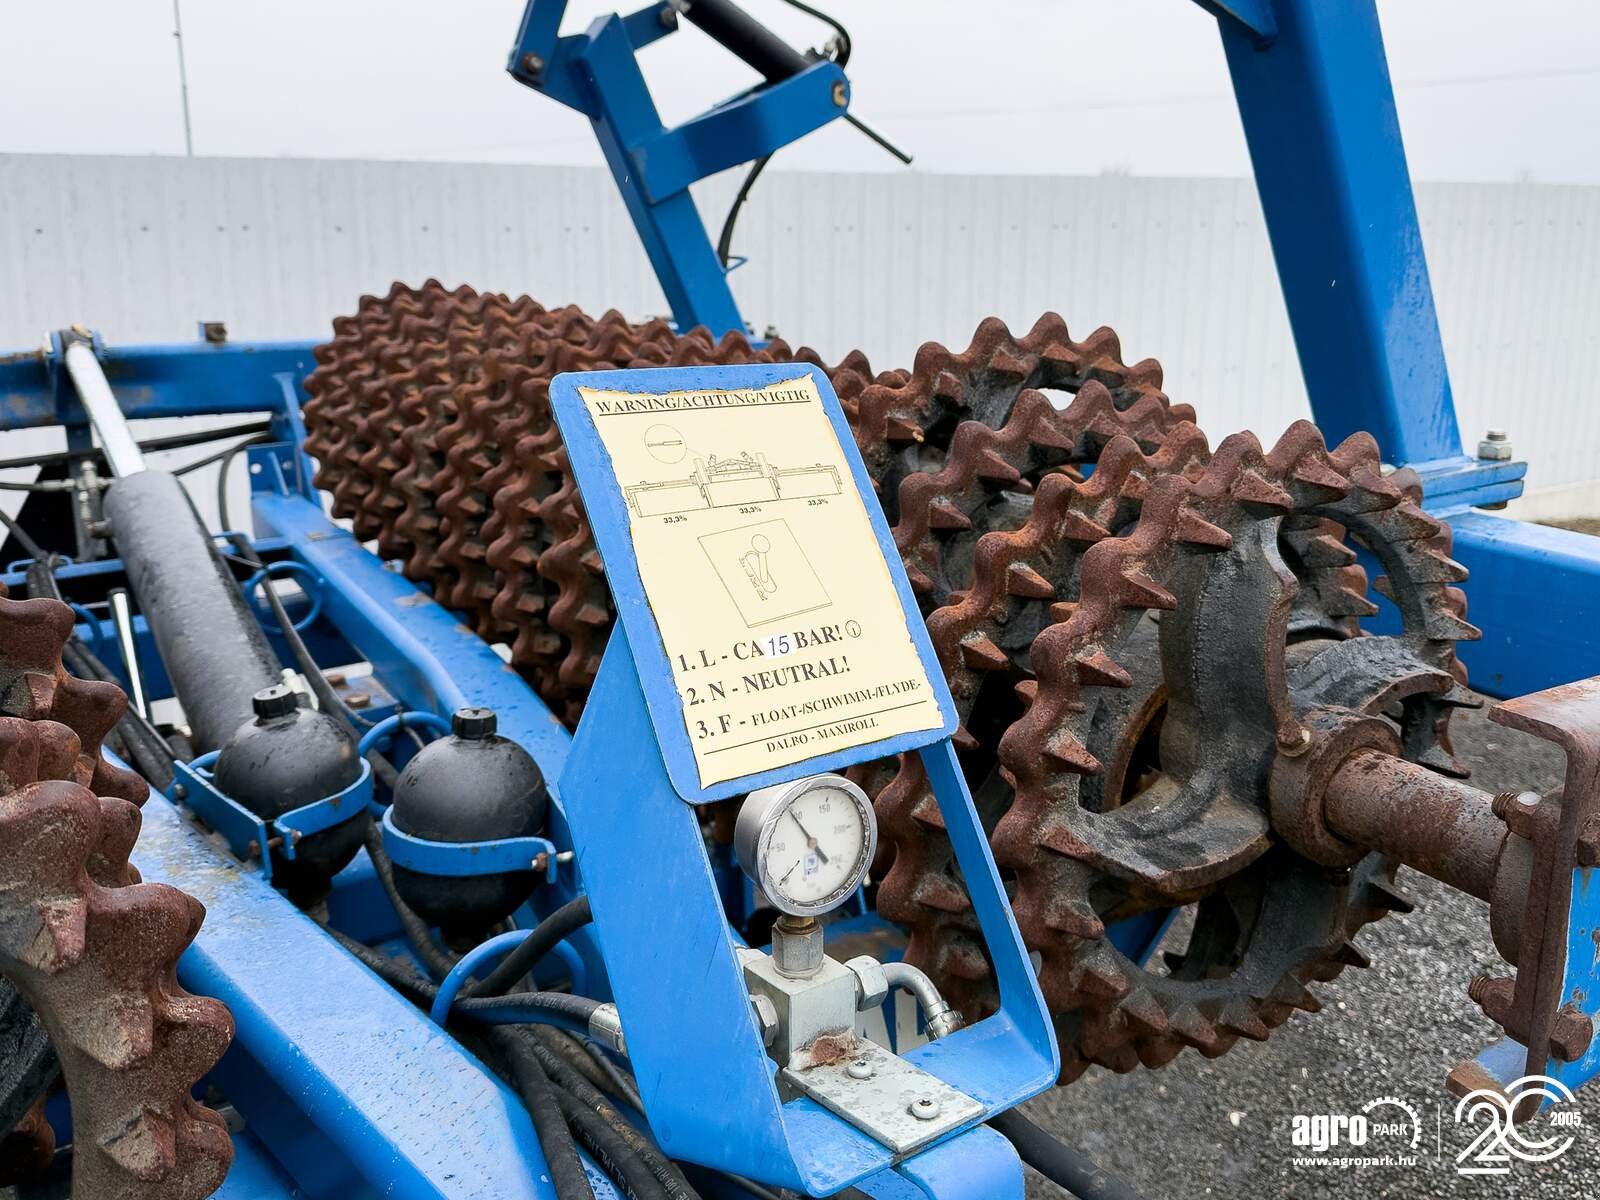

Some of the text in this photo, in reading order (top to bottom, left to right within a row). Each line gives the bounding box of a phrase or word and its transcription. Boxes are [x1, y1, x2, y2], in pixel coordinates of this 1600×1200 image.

[596, 390, 810, 413] WARNING/ACHTUNG/VIGTIG
[663, 514, 688, 524] 33,3%
[739, 505, 762, 514] 33,3%
[678, 653, 696, 672] 1.
[699, 649, 716, 667] L
[733, 639, 764, 661] CA
[768, 634, 790, 657] 15
[793, 624, 843, 649] BAR!
[686, 687, 705, 706] 2.
[708, 681, 726, 701] N
[742, 655, 851, 694] NEUTRAL!
[696, 720, 715, 740] 3.
[718, 714, 732, 734] F
[766, 734, 808, 753] DALBO
[816, 717, 879, 742] MAXIROLL
